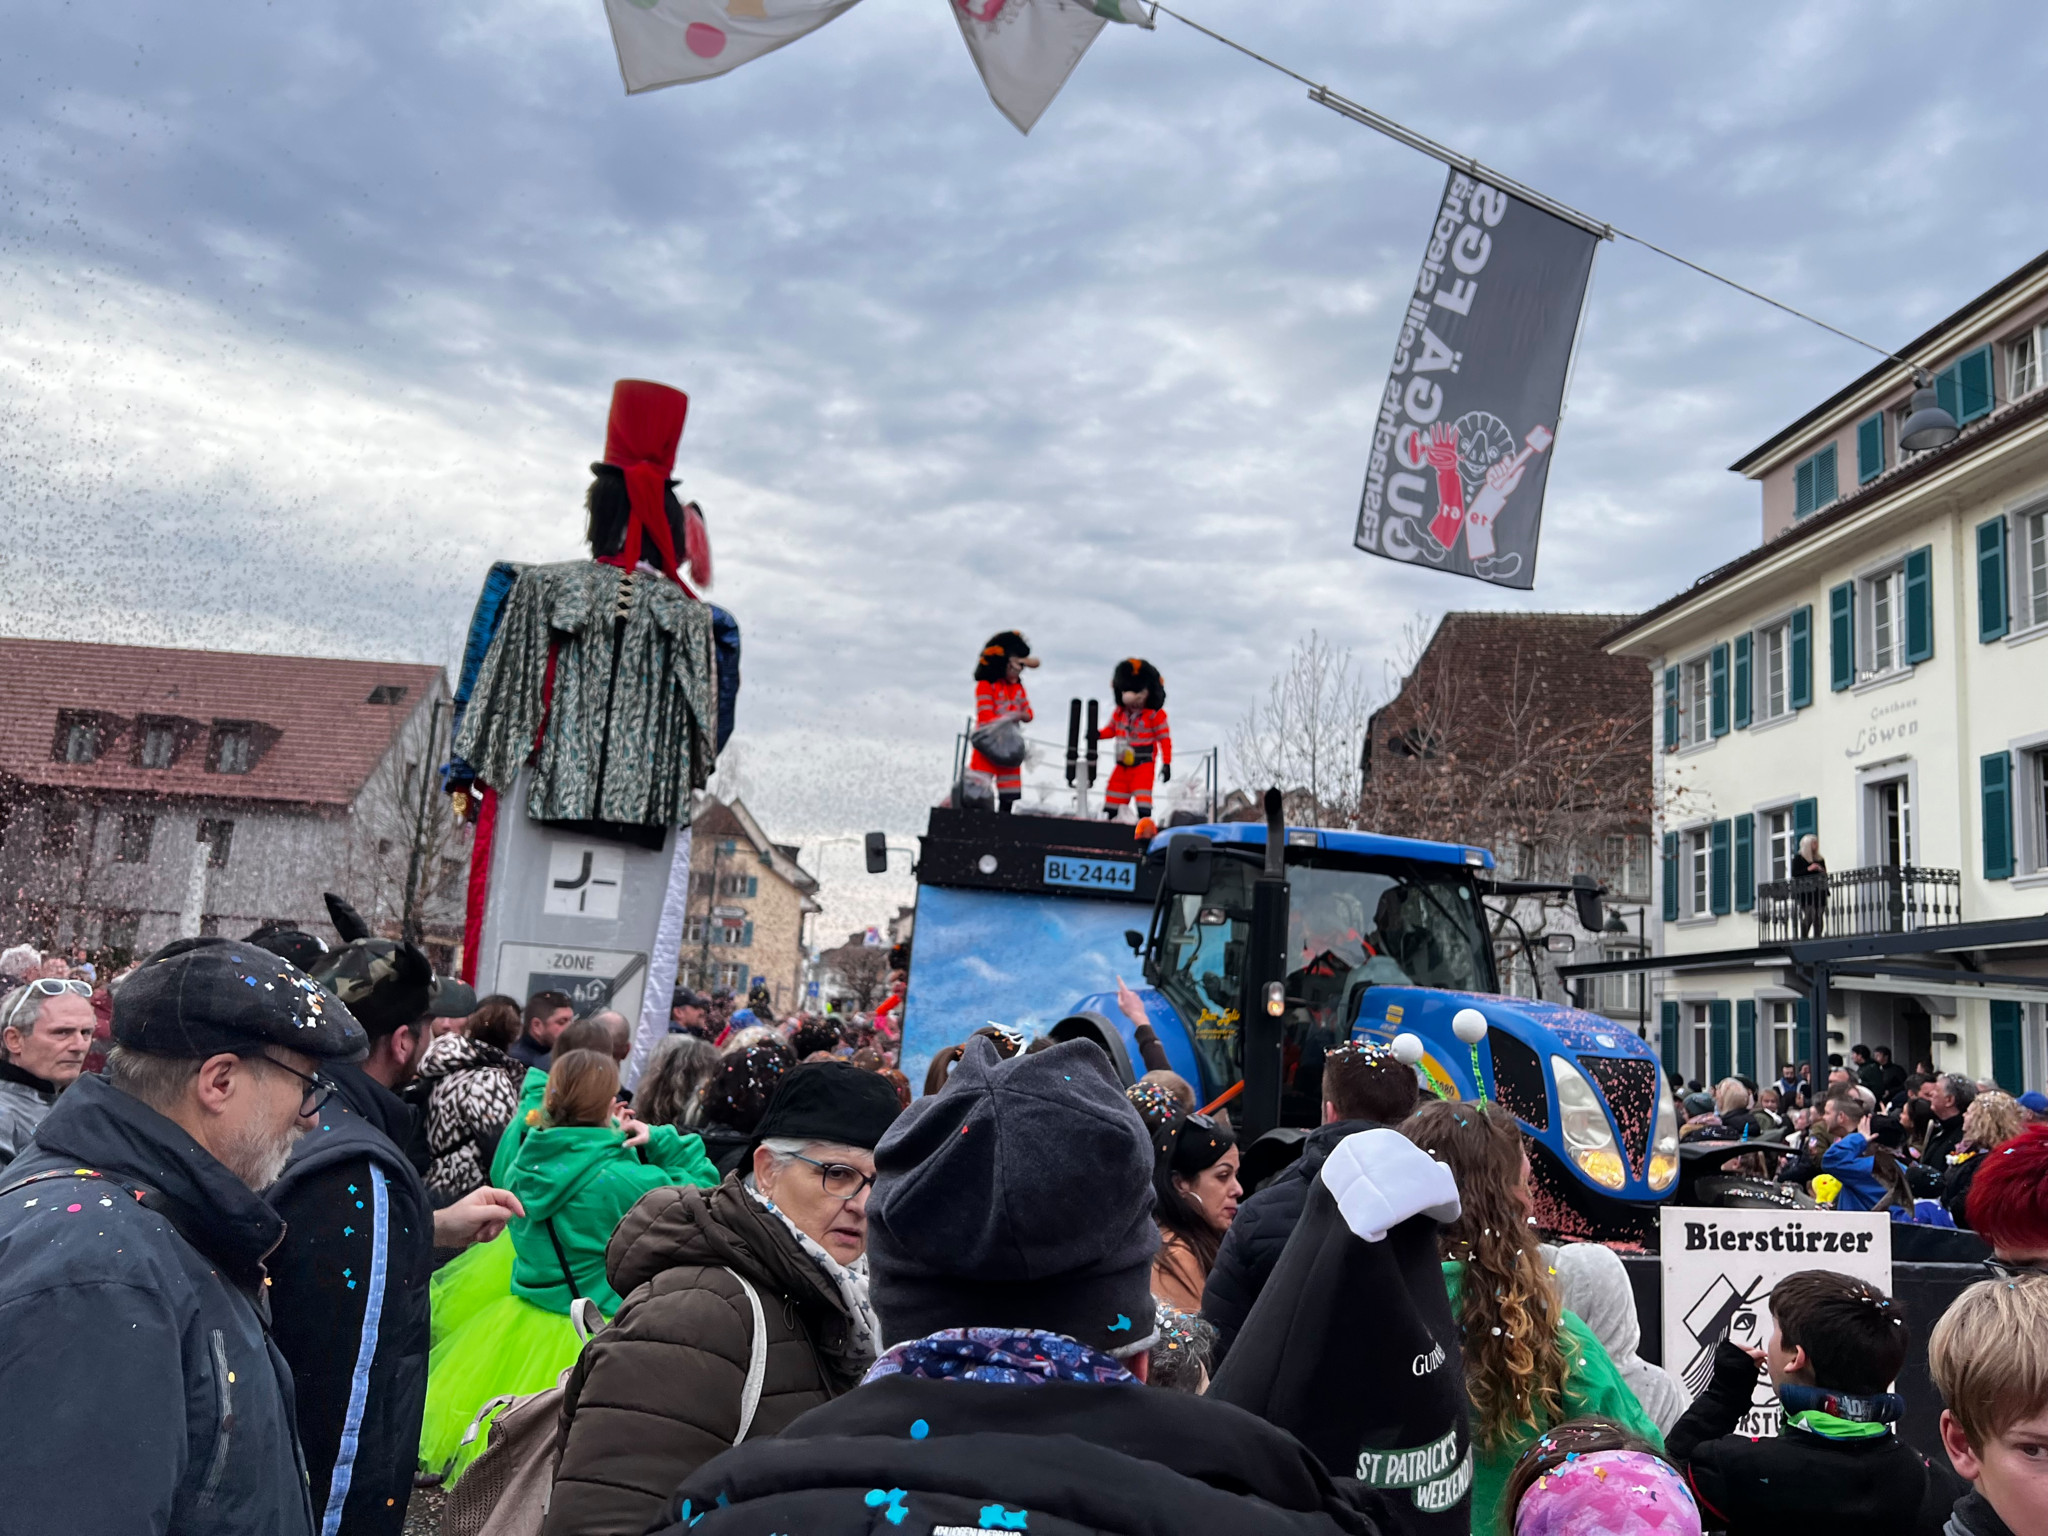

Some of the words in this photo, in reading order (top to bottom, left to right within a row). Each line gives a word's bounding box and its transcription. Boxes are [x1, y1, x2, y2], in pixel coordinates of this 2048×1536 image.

[1845, 719, 1919, 758] Löwen
[553, 953, 596, 971] ZONE
[1684, 1223, 1873, 1252] Bierstürzer
[1356, 1452, 1382, 1484] ST
[1385, 1431, 1457, 1484] PATRICK'S
[1417, 1460, 1470, 1508] WEEKEND
